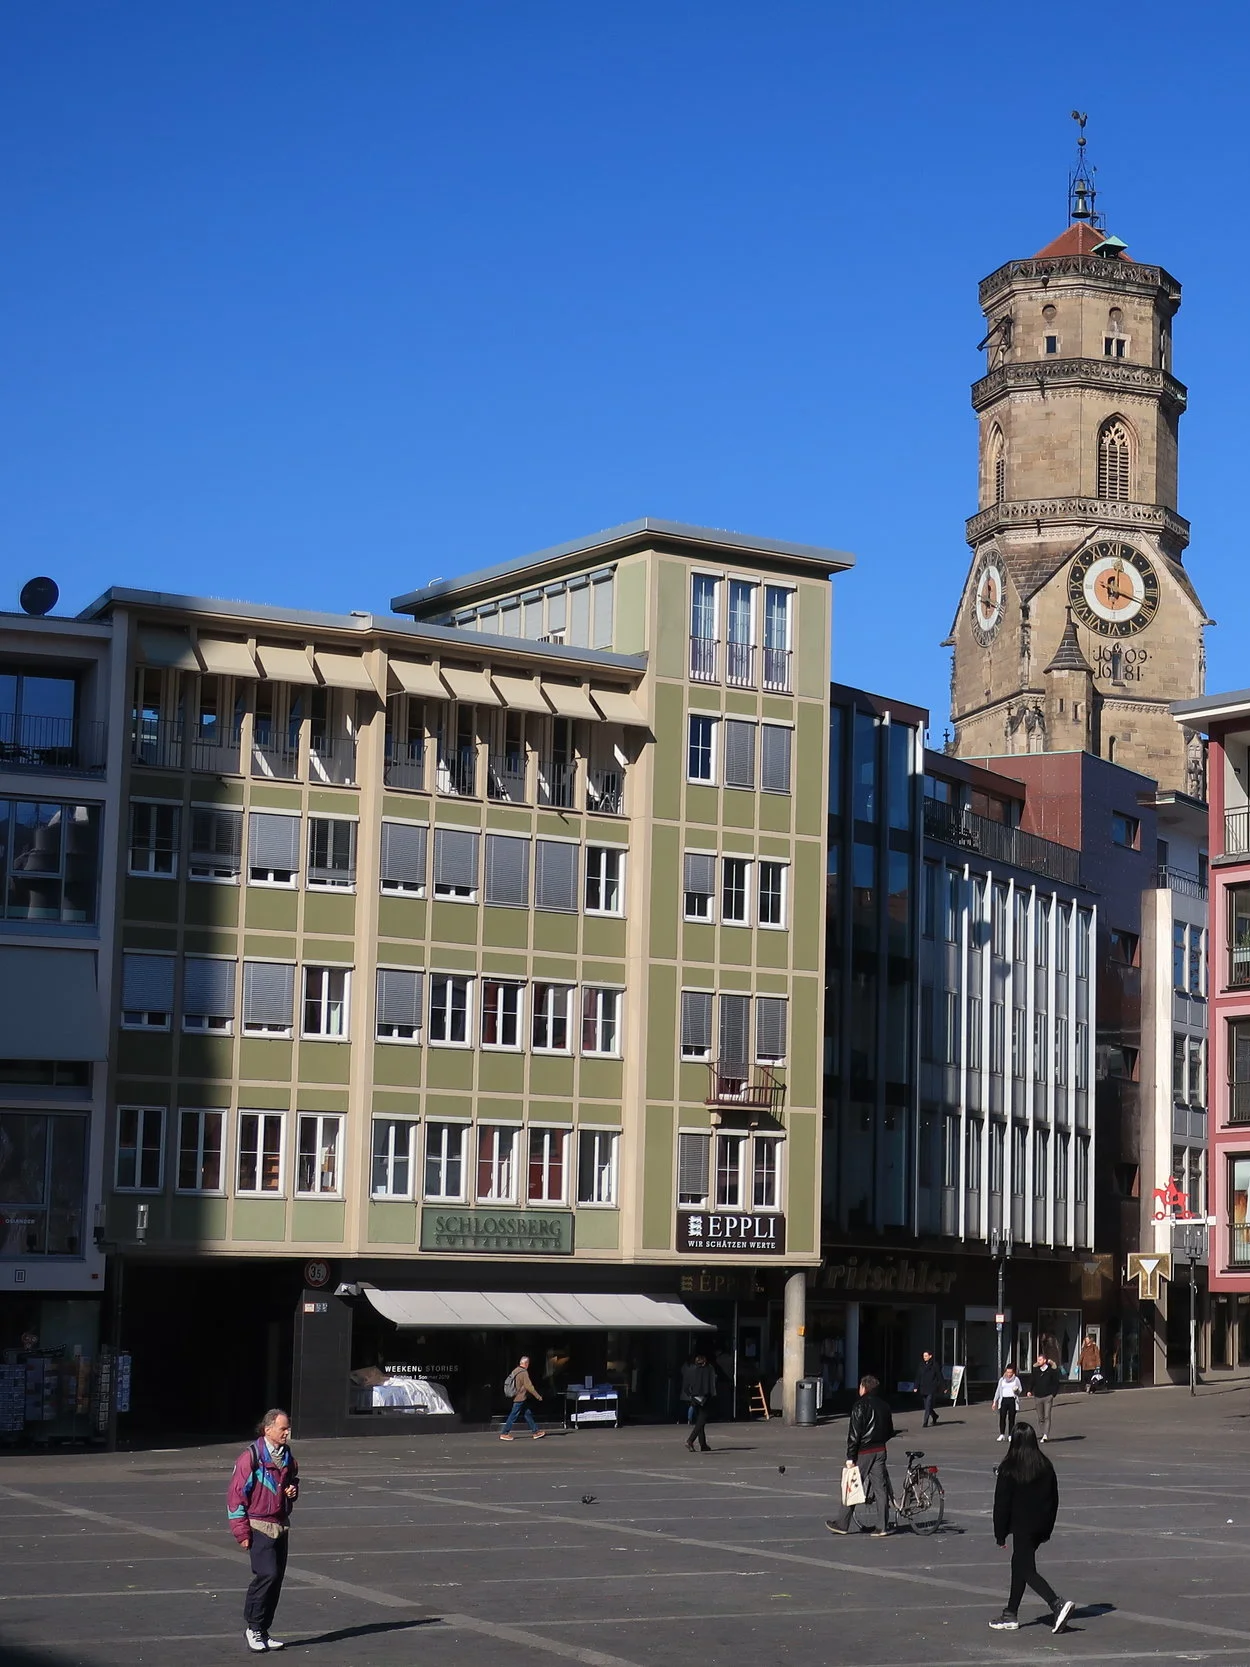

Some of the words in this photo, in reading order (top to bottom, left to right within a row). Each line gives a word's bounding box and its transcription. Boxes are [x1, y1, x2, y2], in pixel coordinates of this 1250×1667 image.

[435, 1216, 561, 1236] SCHLOSSBERG
[708, 1216, 776, 1238] EPPLI
[688, 1240, 703, 1248] WIR
[706, 1240, 747, 1249] SCHÄTZEN
[749, 1241, 776, 1249] WERTE
[385, 1365, 422, 1373] WEEKEND
